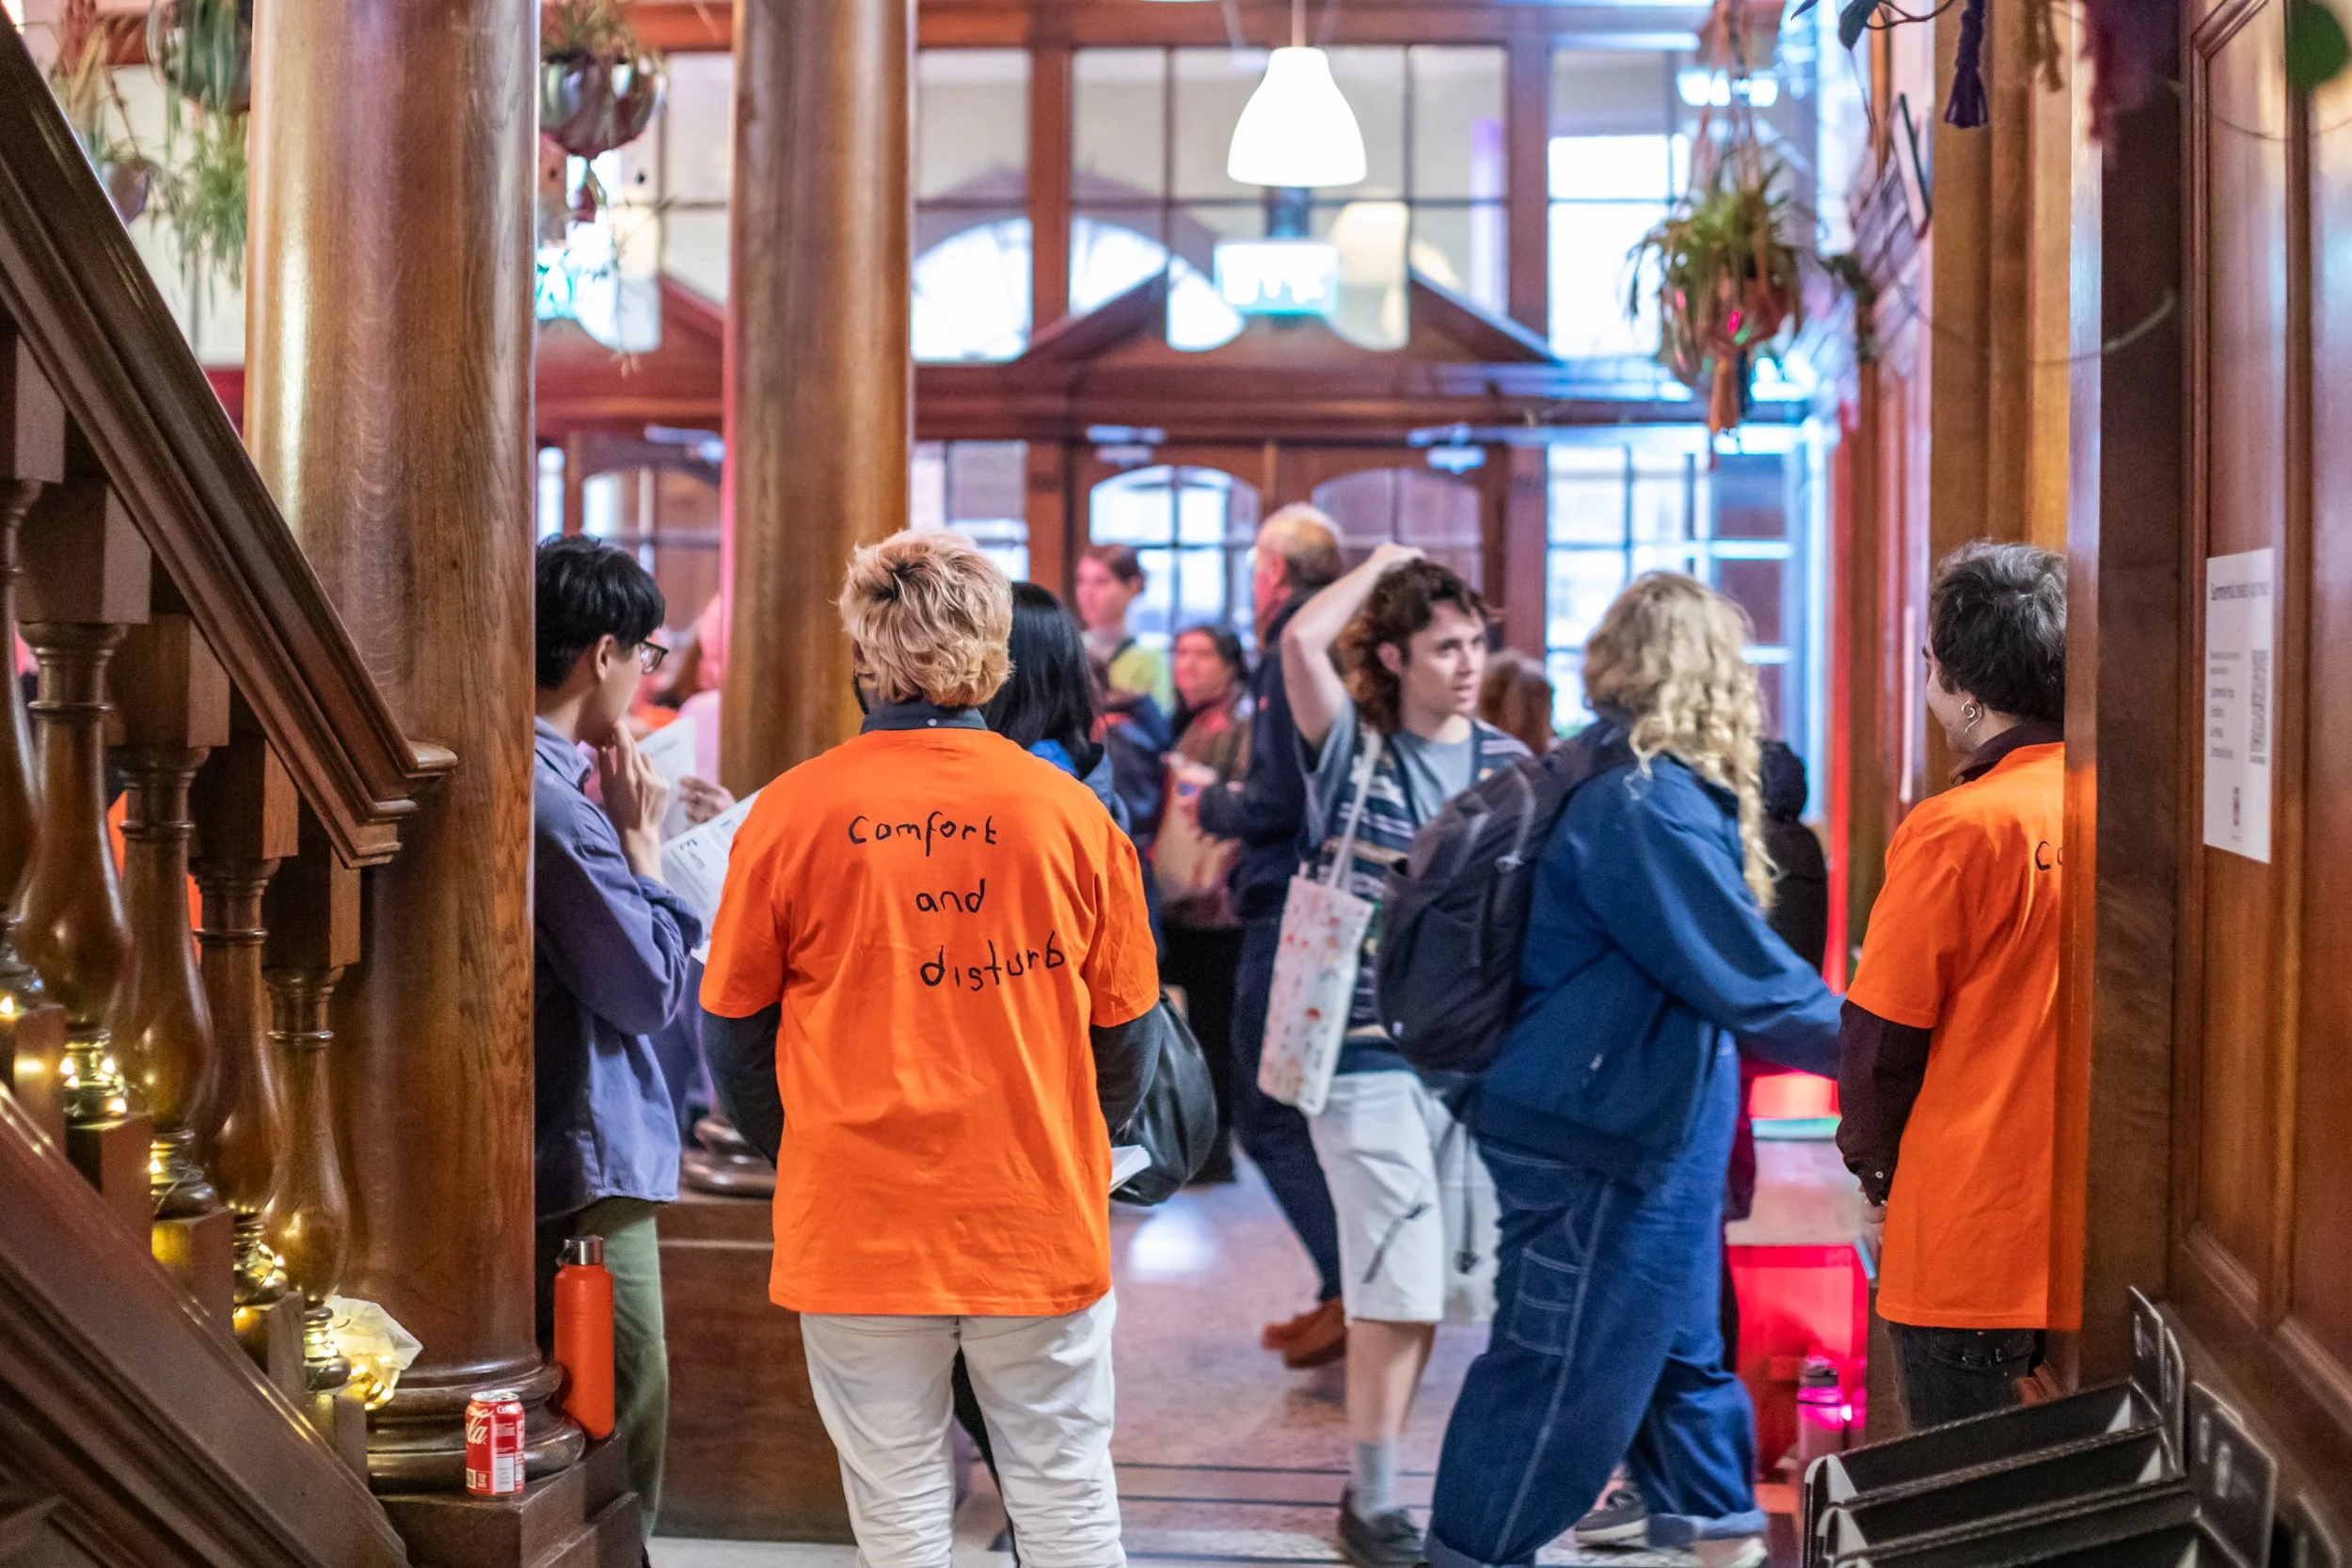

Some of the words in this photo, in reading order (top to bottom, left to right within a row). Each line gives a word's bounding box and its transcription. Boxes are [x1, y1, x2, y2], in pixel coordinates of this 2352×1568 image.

[848, 810, 997, 858] Comfort
[915, 878, 986, 913] and
[920, 930, 1066, 992] disturb
